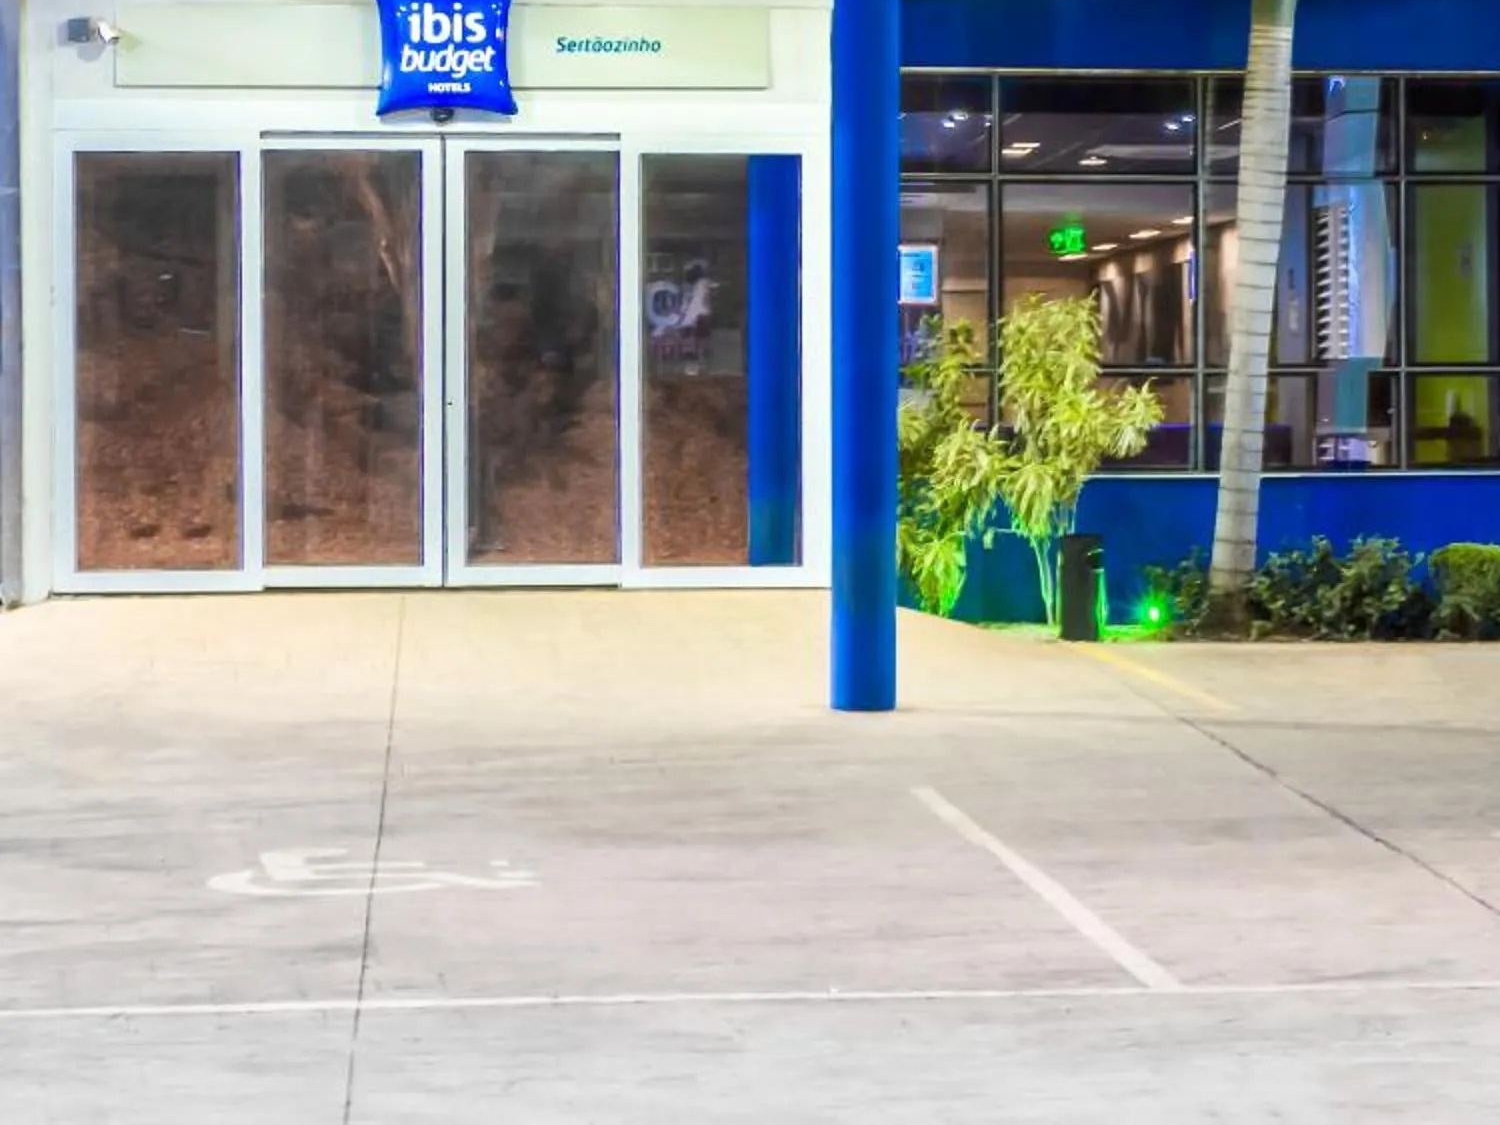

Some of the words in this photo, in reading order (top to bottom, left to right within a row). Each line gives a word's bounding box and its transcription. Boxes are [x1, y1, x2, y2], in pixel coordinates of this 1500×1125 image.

[408, 2, 487, 43] ibis
[556, 36, 661, 53] Sertãozinho
[400, 43, 497, 78] budget
[428, 83, 471, 93] HOTELS
